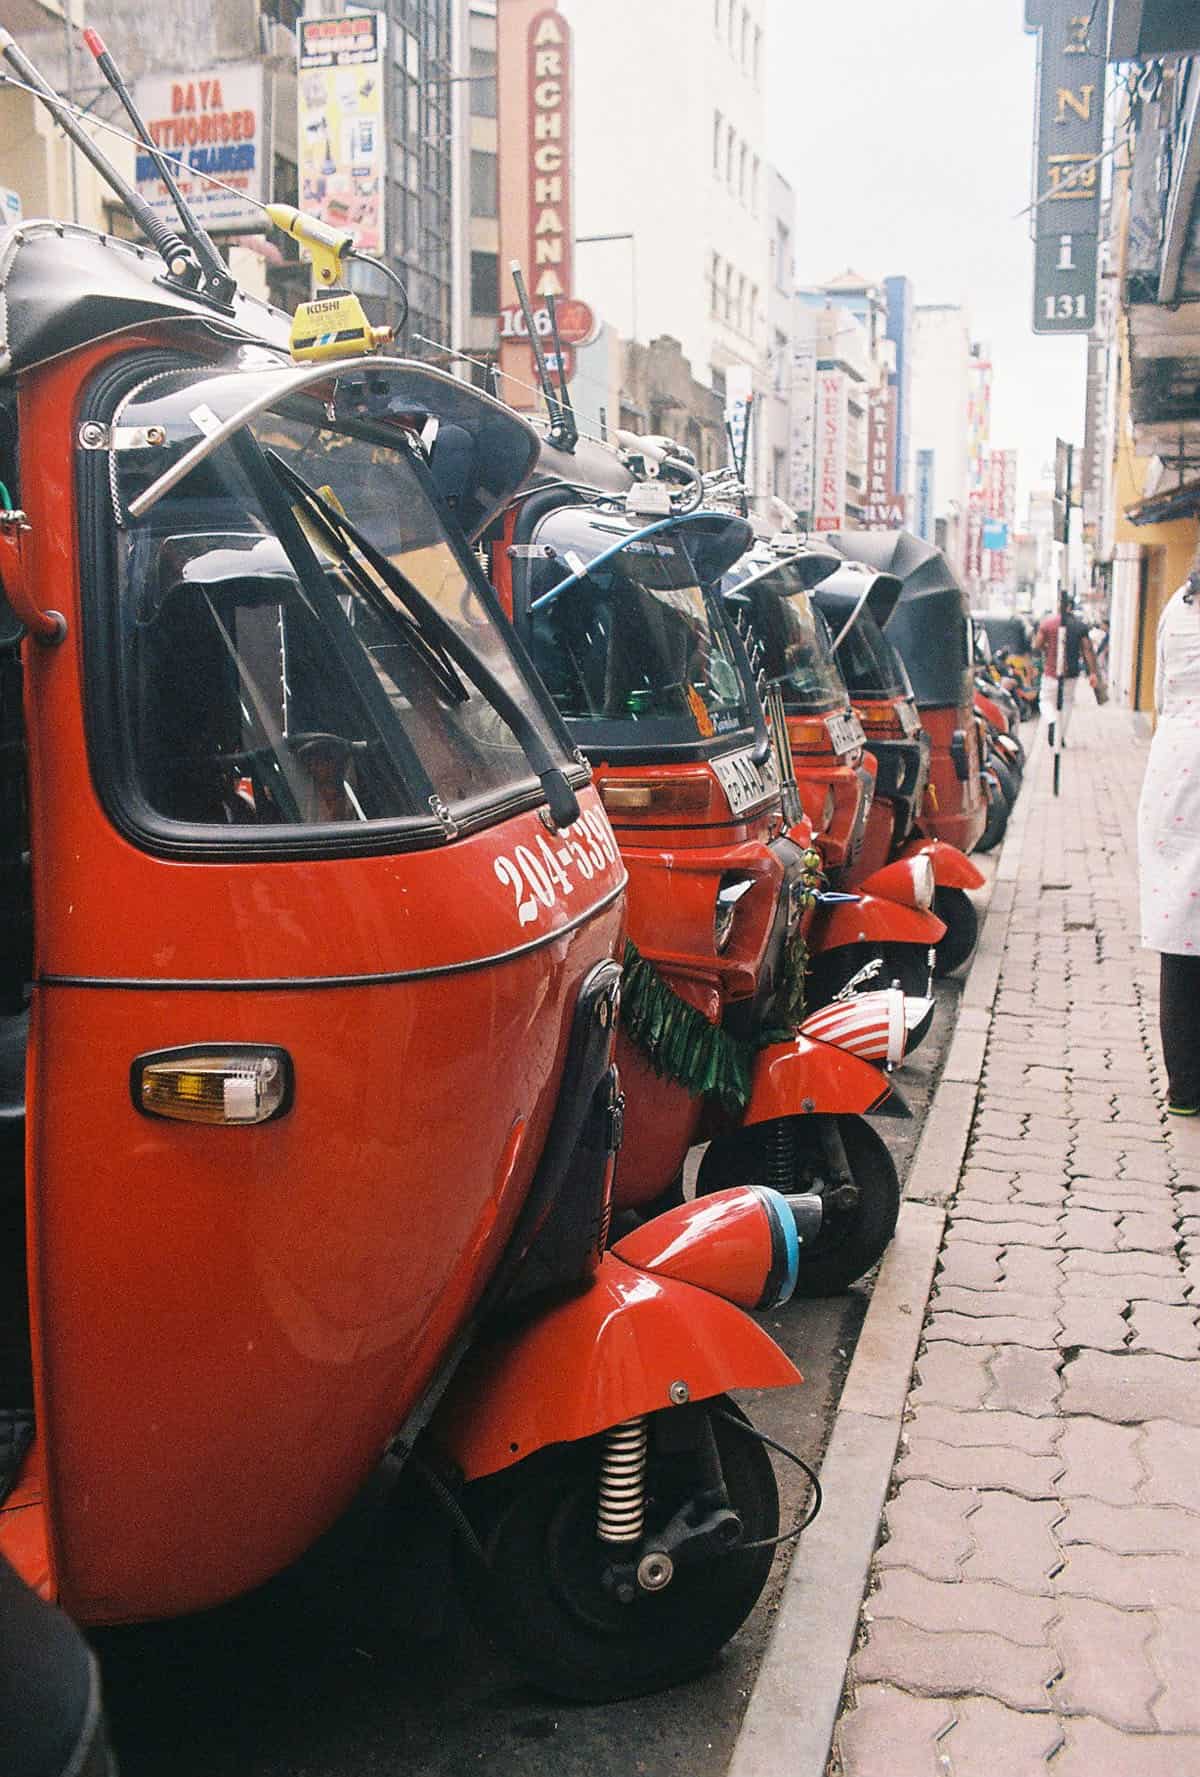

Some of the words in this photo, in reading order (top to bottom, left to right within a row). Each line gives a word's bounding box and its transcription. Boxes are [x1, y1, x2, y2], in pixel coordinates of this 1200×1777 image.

[172, 80, 223, 114] DAYA
[534, 17, 564, 297] ARCHCHANA
[307, 301, 340, 315] KOSHI
[1045, 294, 1088, 320] 131
[501, 309, 553, 336] 106
[821, 376, 839, 512] WESTERN
